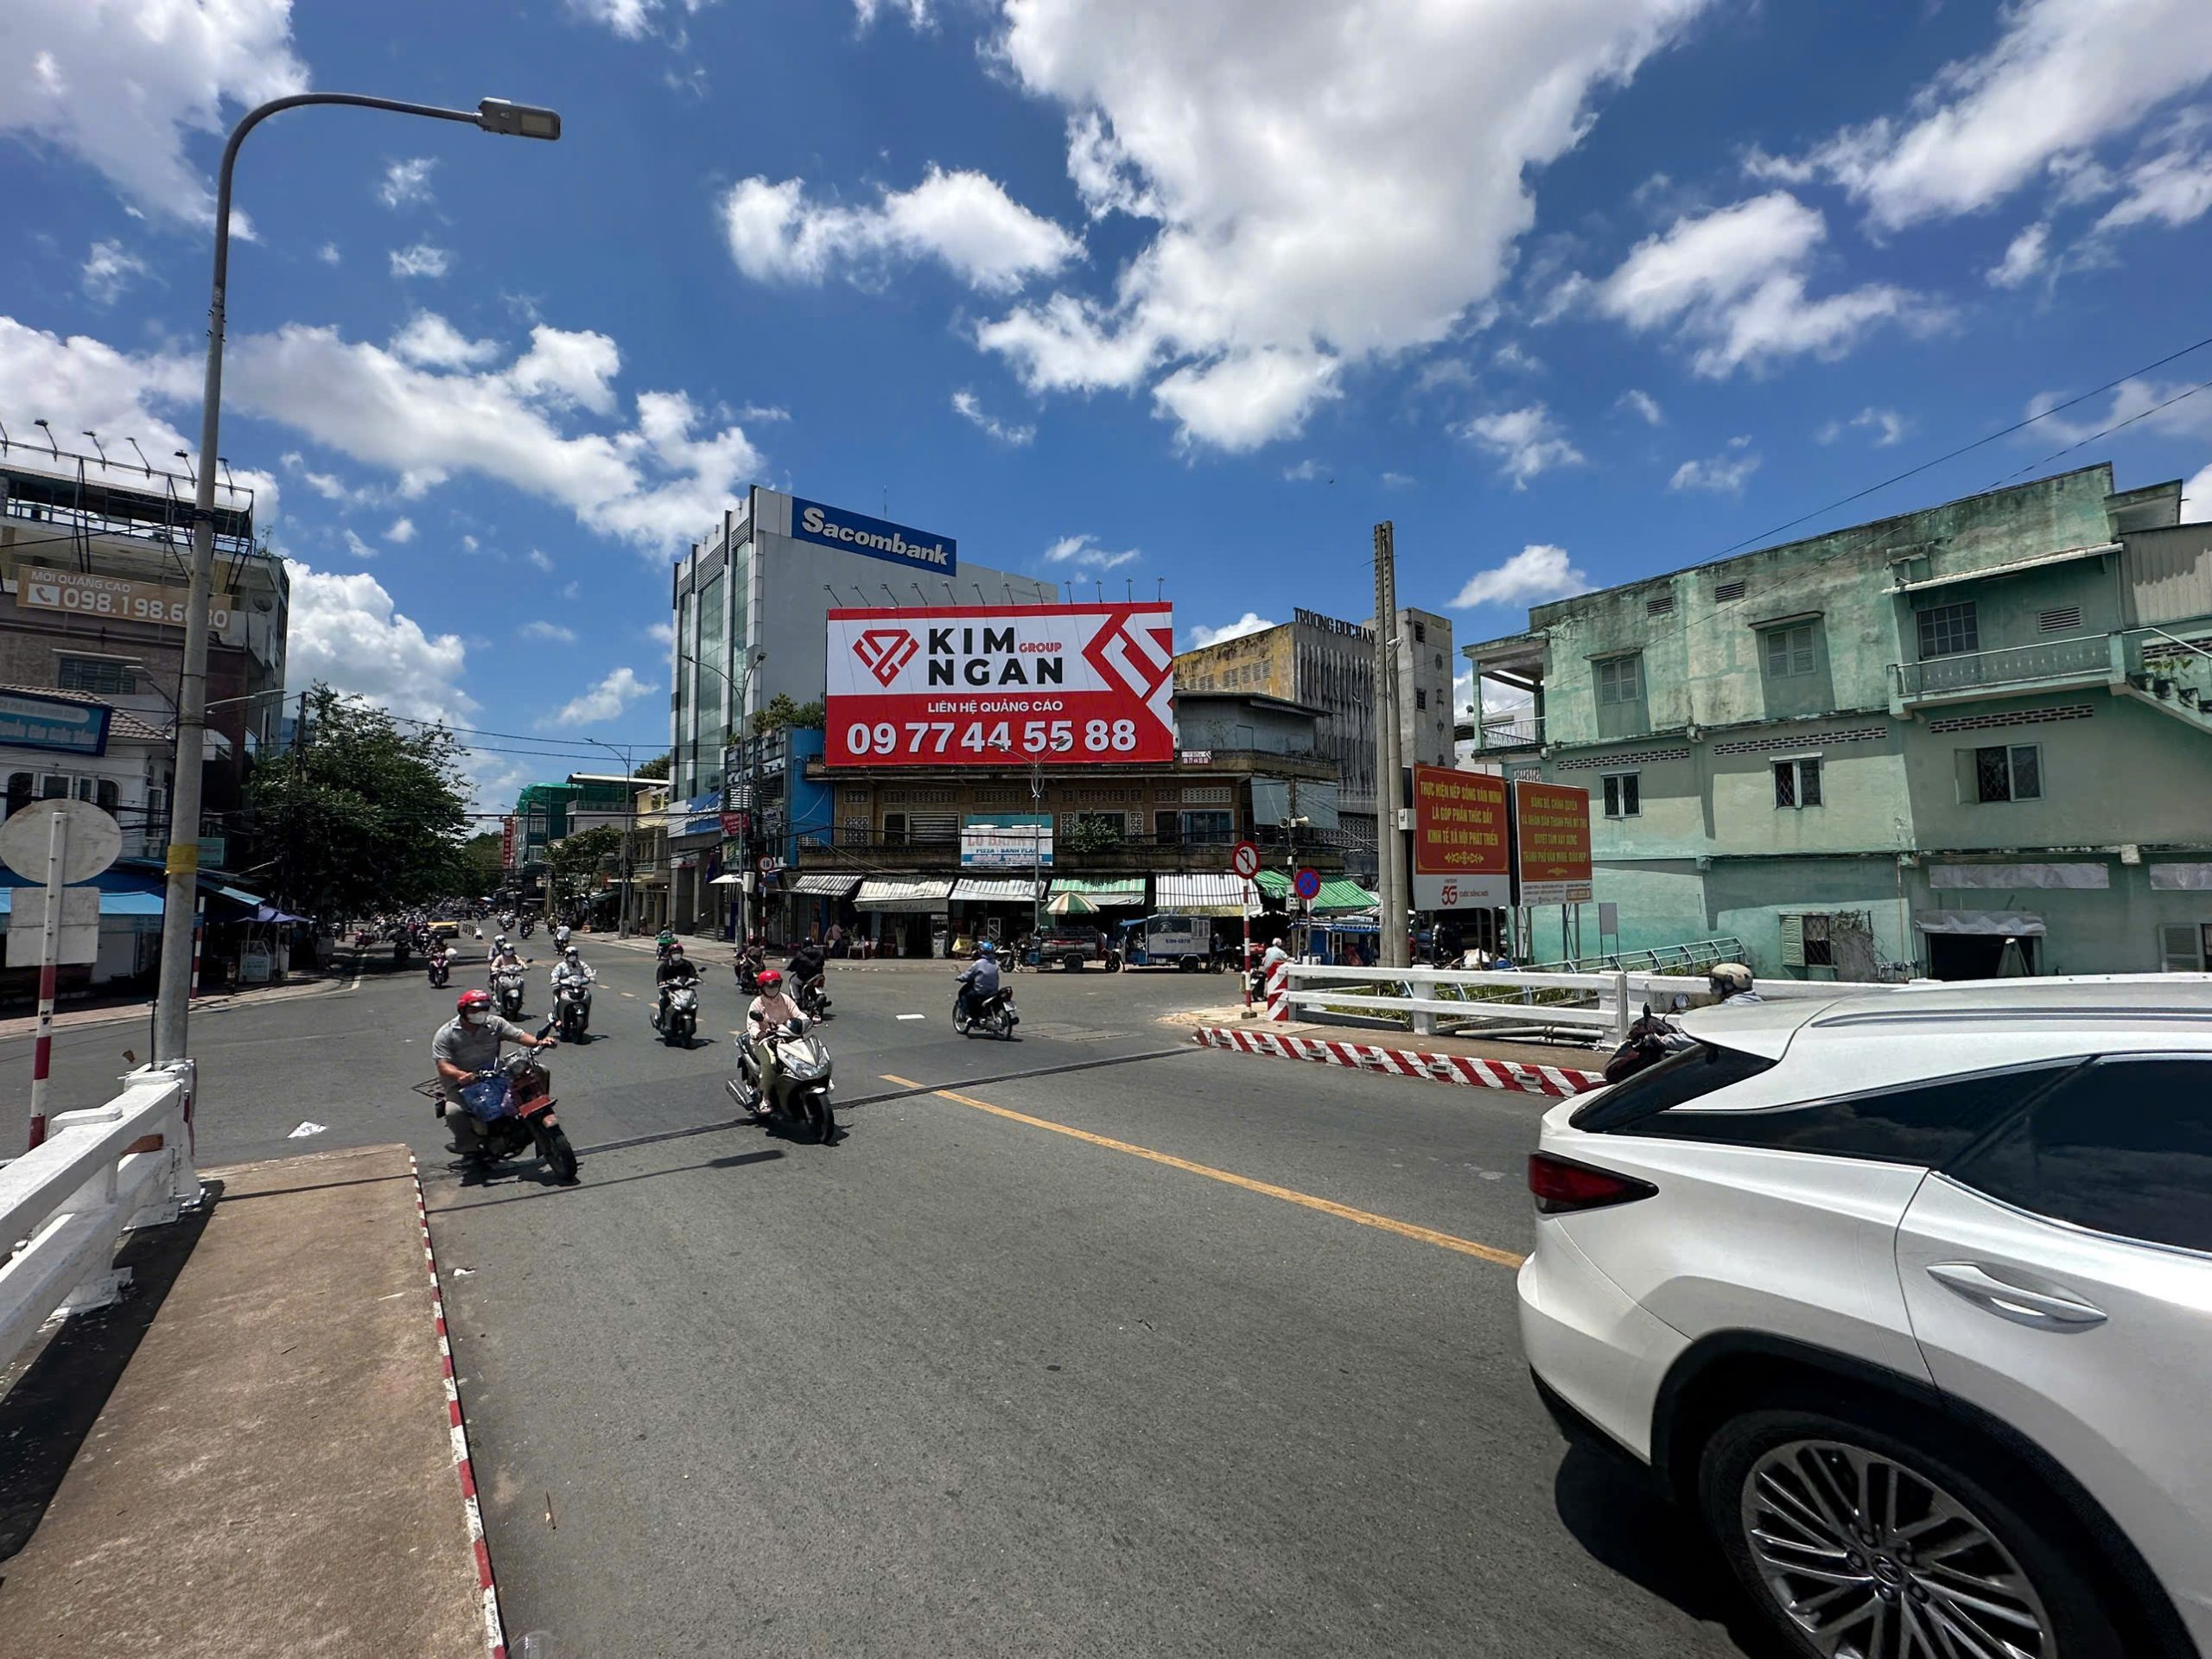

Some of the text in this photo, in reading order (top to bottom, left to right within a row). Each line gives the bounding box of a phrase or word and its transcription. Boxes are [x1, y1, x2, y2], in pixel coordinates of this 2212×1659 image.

[802, 506, 949, 566] Sacombank
[63, 588, 227, 628] 098.198.60
[928, 626, 1015, 655] KIM
[1018, 642, 1062, 653] GROUP
[928, 657, 1063, 687] NGAN
[927, 698, 1064, 715] LIÊN HỆ QUẢNG CÁO
[846, 719, 1136, 755] 09 77 44 55 88
[1449, 782, 1460, 799] NẾP
[1442, 826, 1450, 843] TẾ
[1441, 885, 1458, 906] 5G
